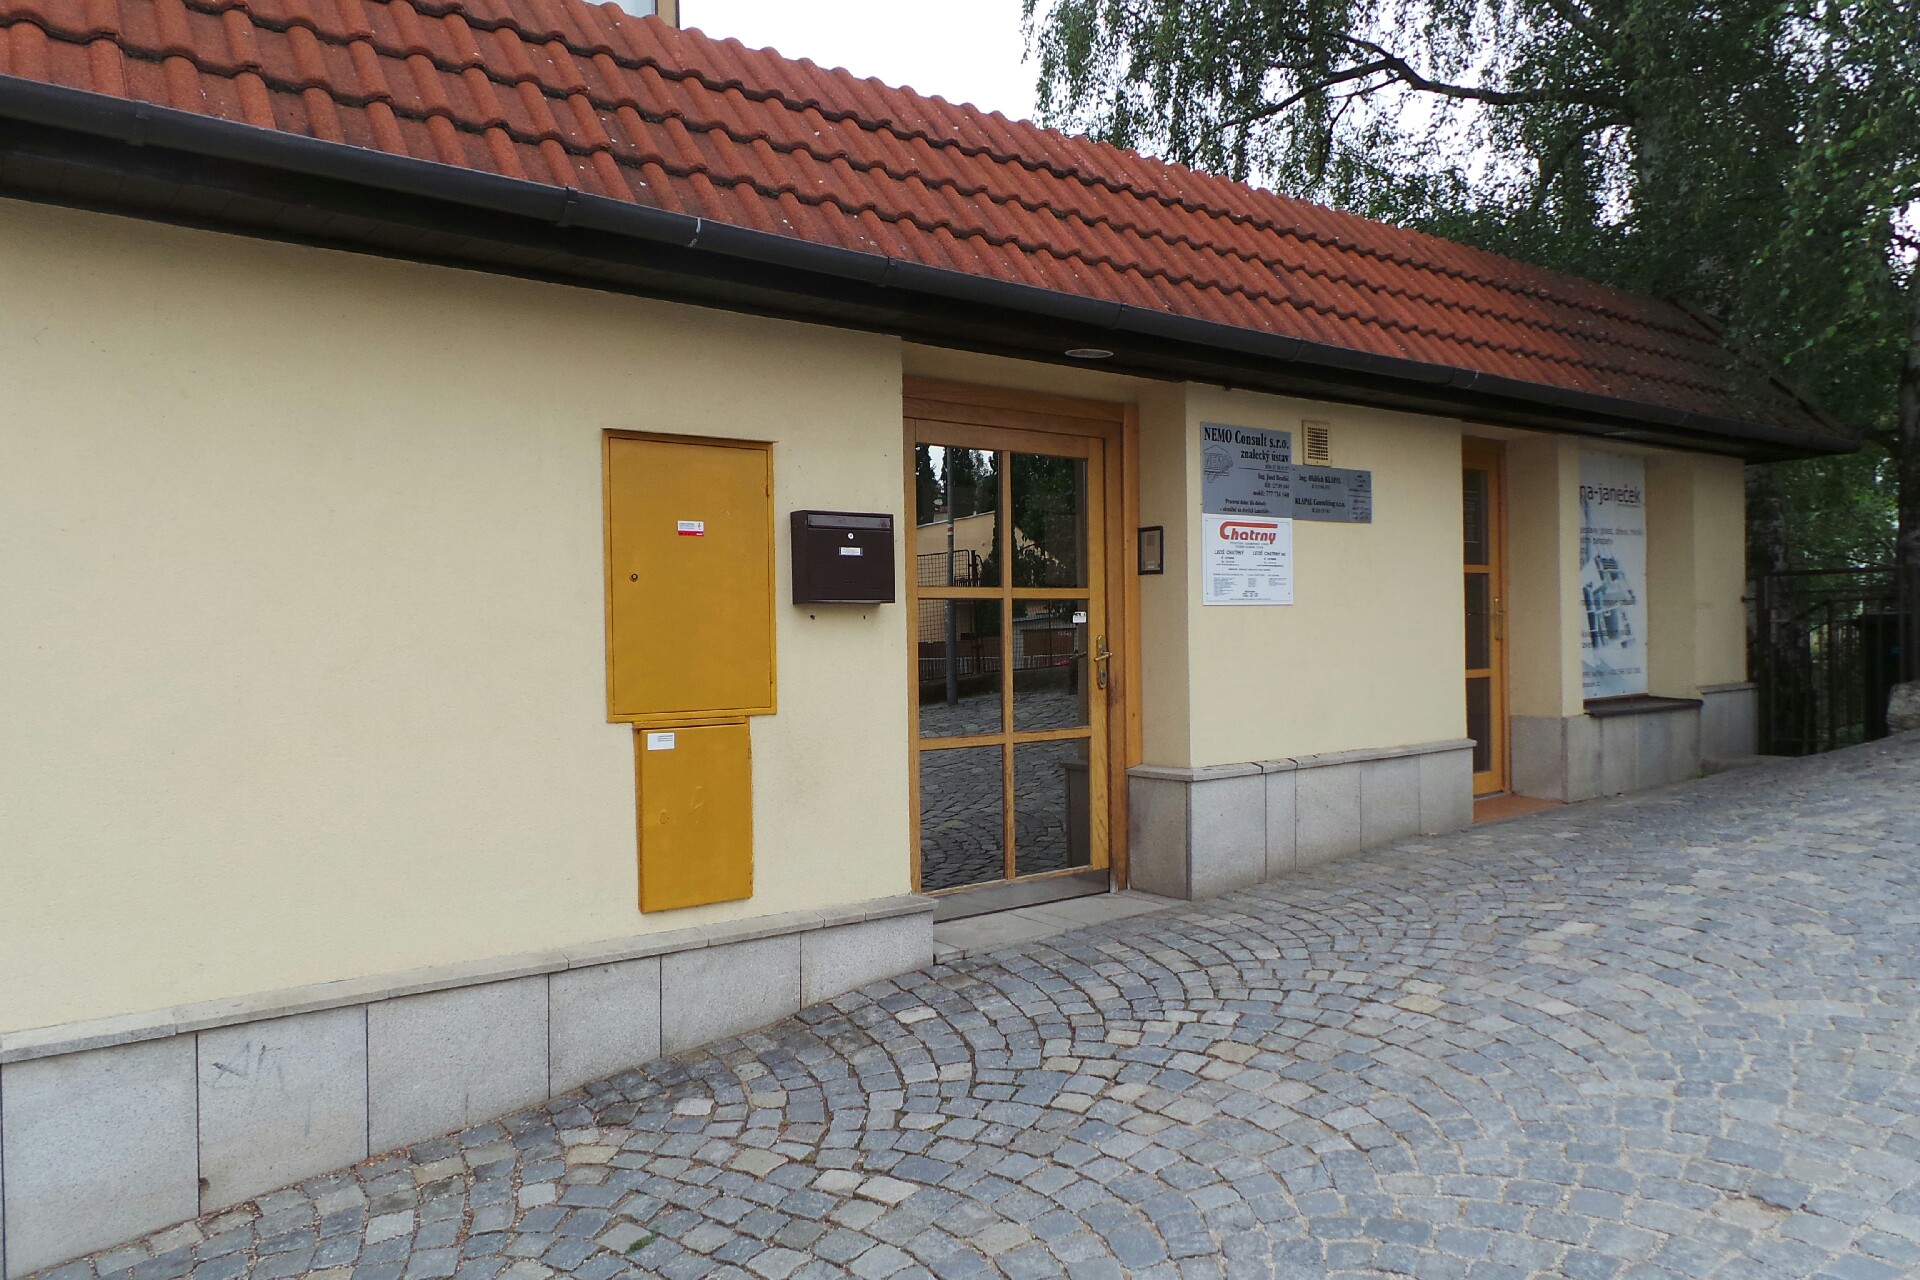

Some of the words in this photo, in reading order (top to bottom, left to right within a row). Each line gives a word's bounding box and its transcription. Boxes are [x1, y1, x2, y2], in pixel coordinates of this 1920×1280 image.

[1204, 427, 1232, 443] NEMO
[1235, 430, 1267, 447] Consult
[1269, 438, 1289, 449] s.r.o.
[1240, 448, 1270, 463] znalecký
[1271, 450, 1289, 462] ústav
[1219, 521, 1278, 545] Chatrny
